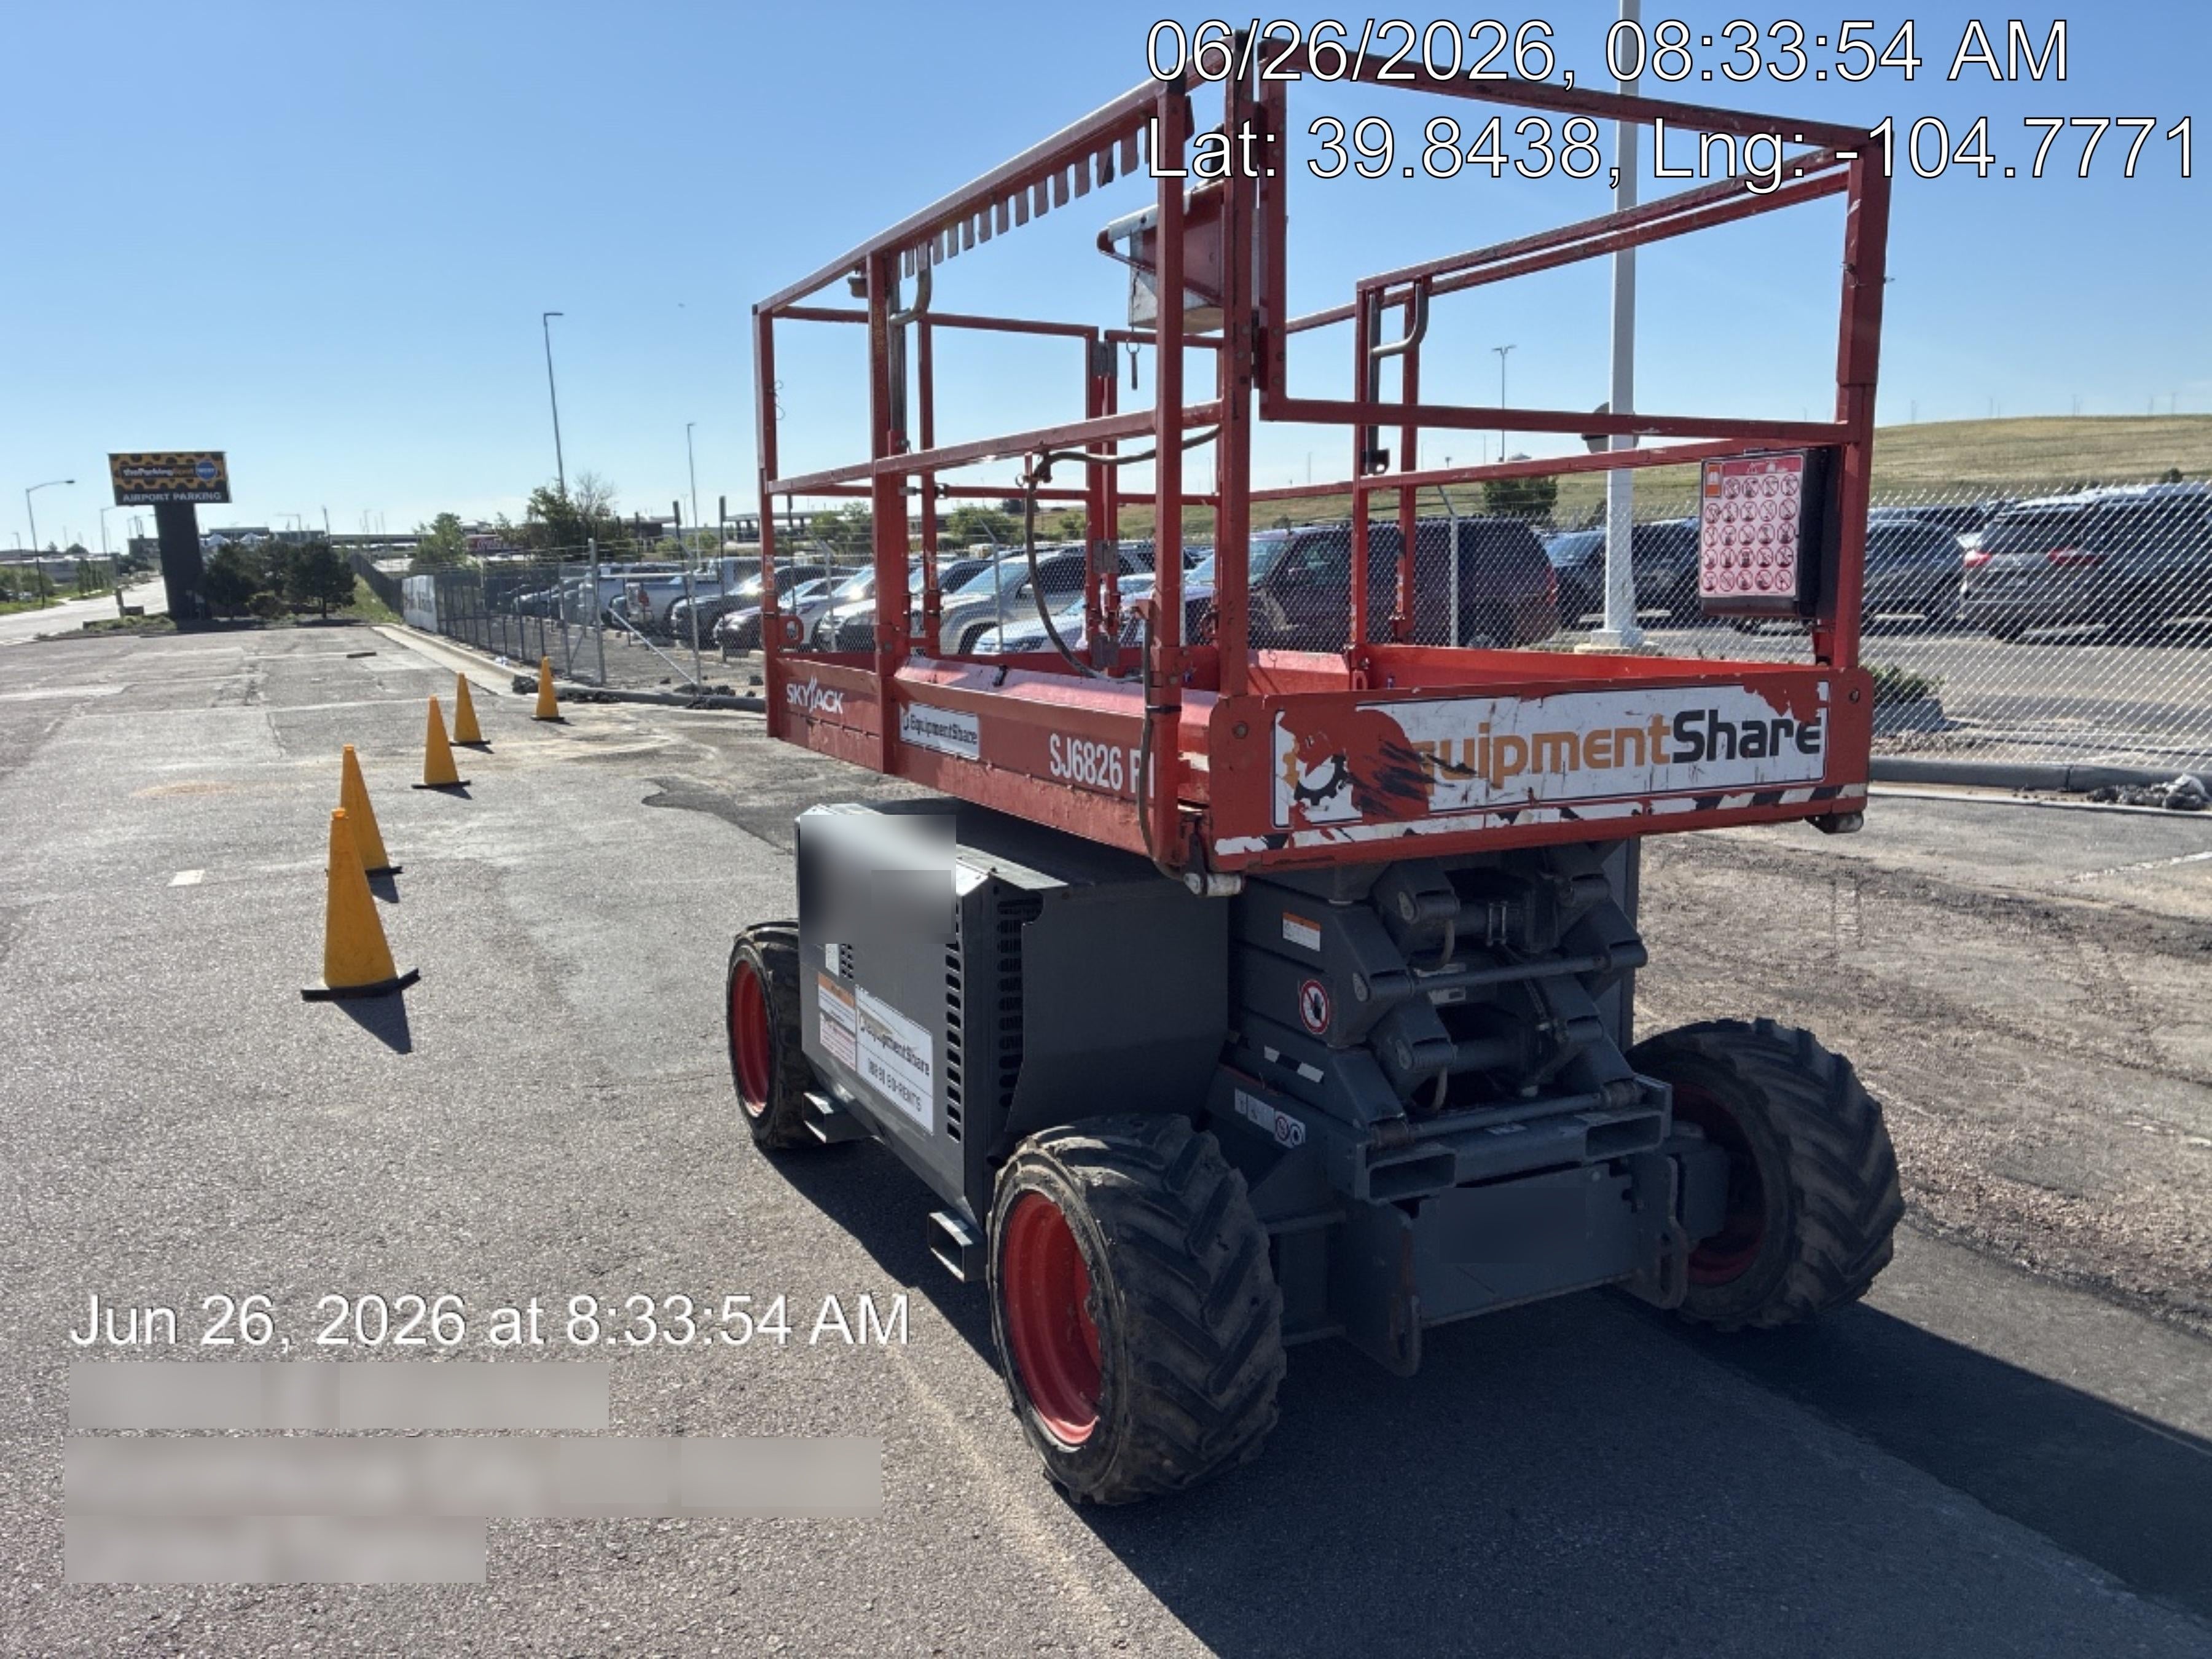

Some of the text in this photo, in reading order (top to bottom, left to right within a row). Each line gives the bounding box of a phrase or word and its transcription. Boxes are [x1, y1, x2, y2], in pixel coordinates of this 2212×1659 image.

[123, 492, 222, 502] AIRPORT PARKING
[786, 675, 845, 715] SKYJACK
[910, 713, 978, 745] EquipmentShare
[1050, 732, 1123, 791] SJ6826
[1412, 708, 1822, 796] quipmentShare
